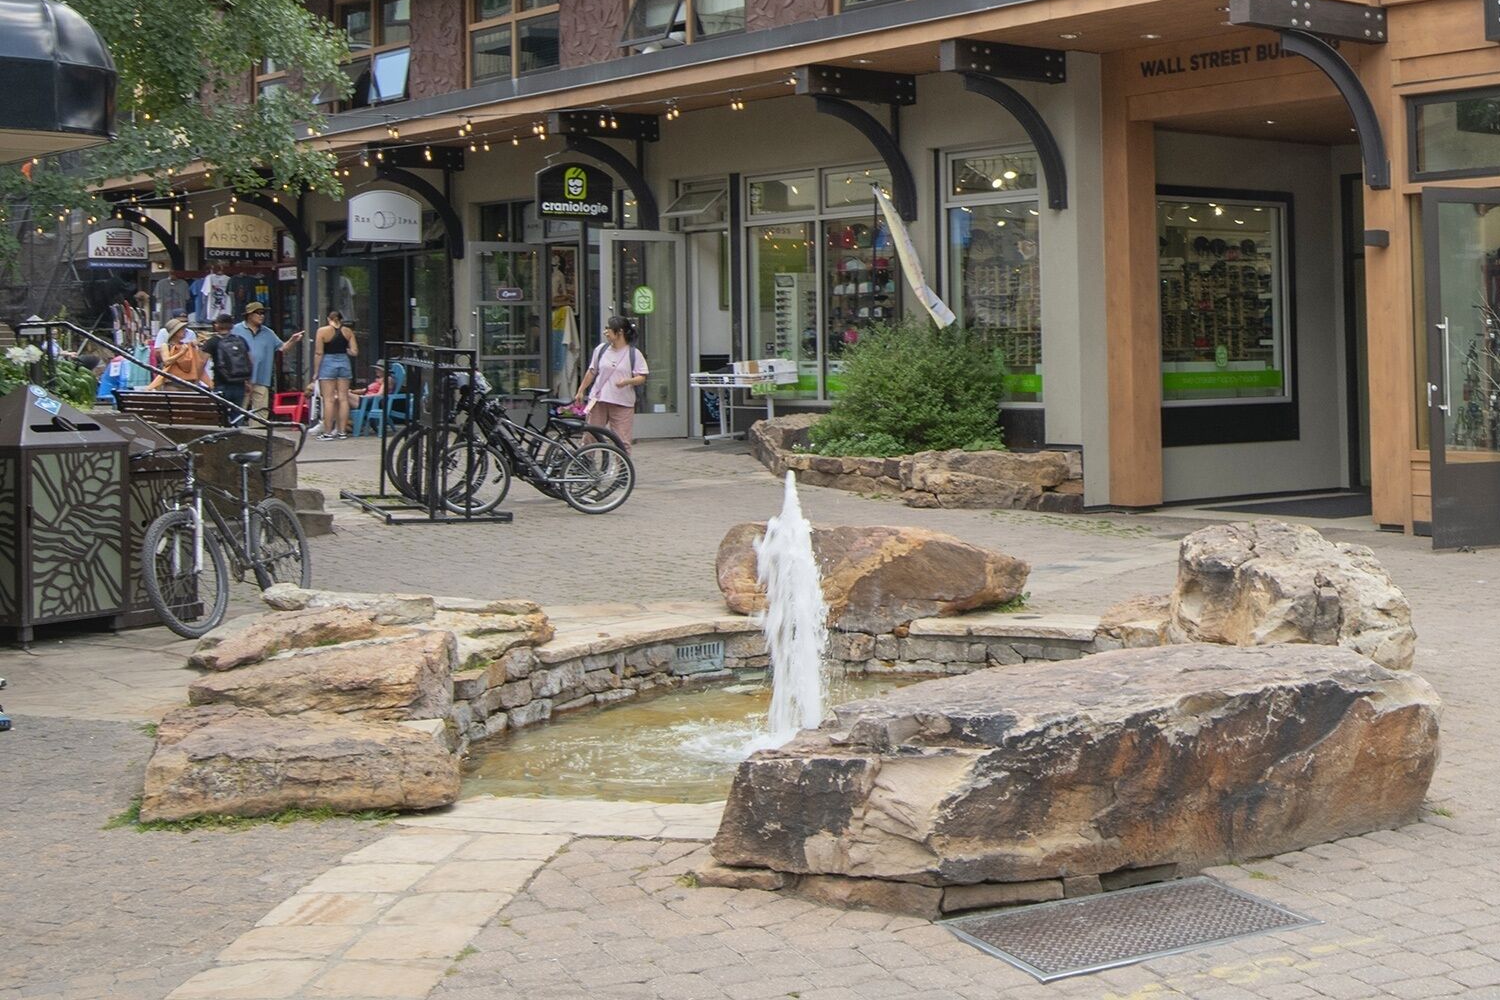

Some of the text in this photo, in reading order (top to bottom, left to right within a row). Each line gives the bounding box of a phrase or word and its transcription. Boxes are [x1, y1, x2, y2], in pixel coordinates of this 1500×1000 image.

[1140, 57, 1186, 77] WALL
[1190, 46, 1251, 71] STREET
[542, 201, 608, 215] craniologie
[224, 222, 256, 233] TWO
[210, 232, 271, 244] ARROWS
[752, 383, 777, 394] SALE
